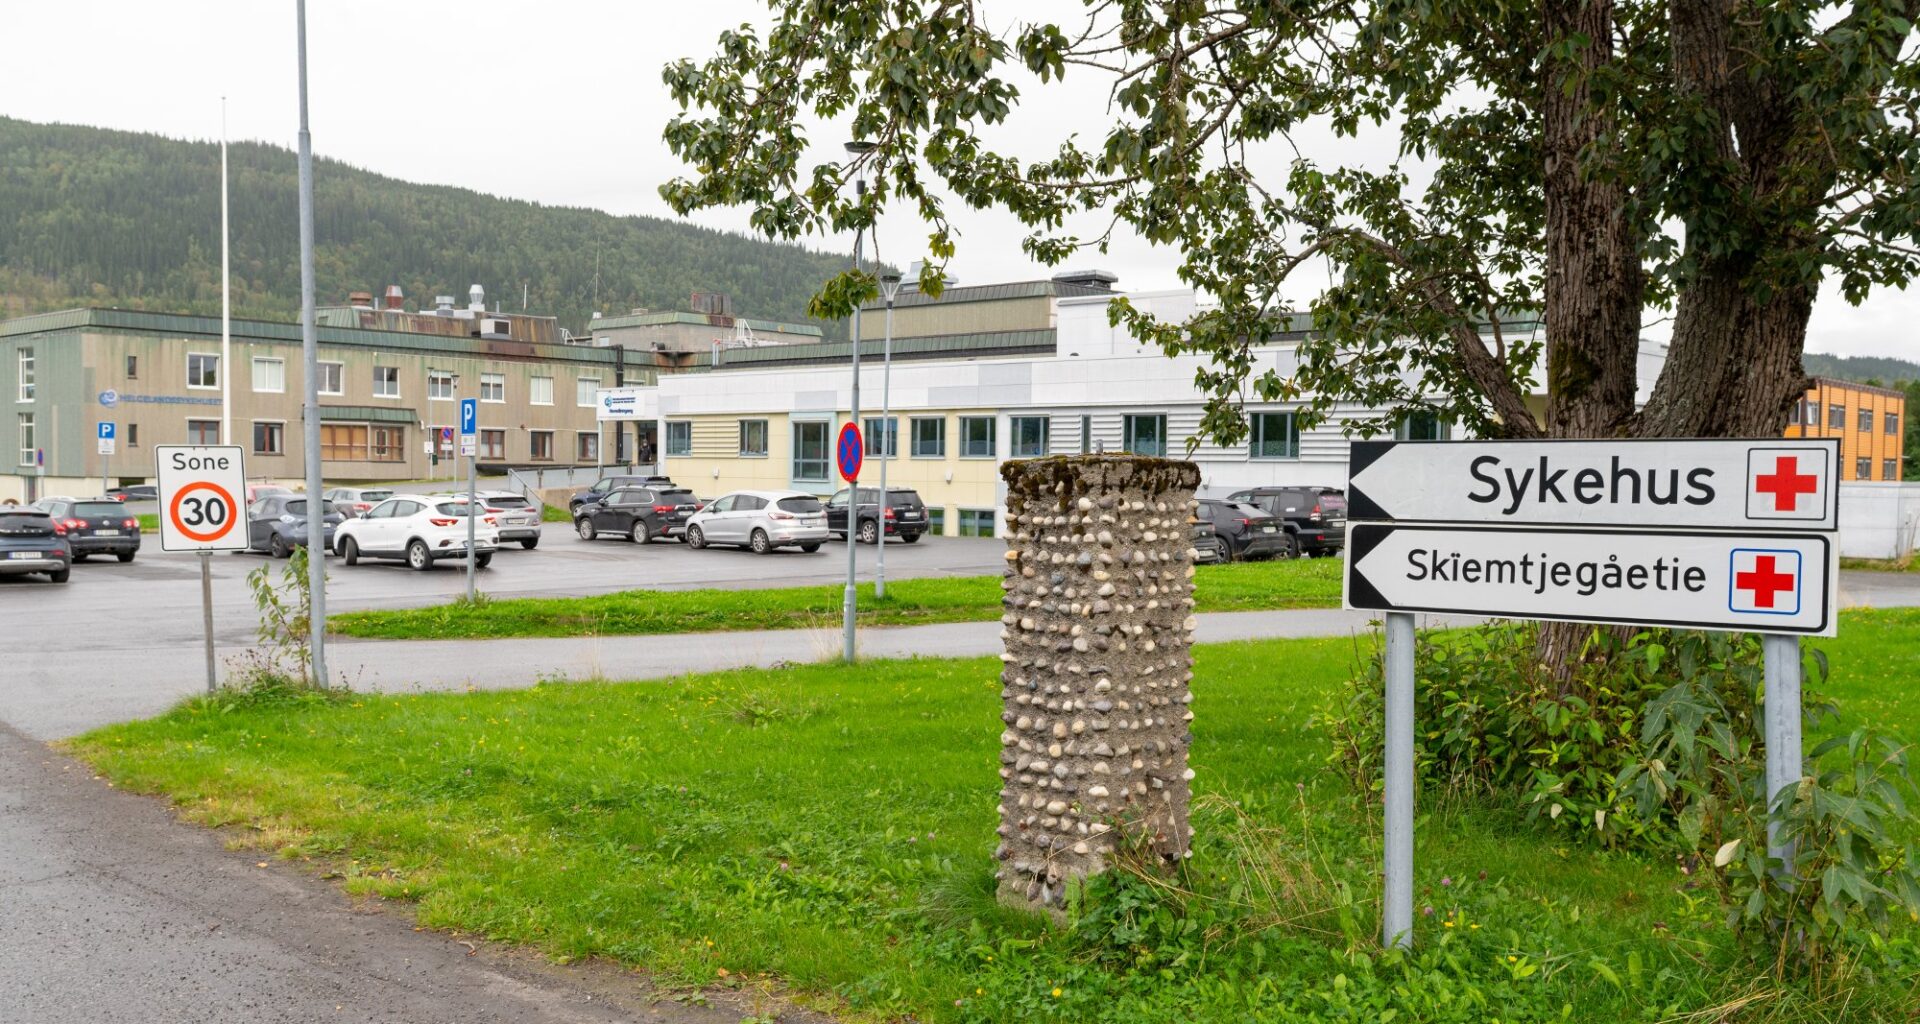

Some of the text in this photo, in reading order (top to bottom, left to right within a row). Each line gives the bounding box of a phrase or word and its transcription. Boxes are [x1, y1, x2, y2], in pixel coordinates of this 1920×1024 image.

[102, 424, 112, 437] P
[464, 403, 473, 430] P
[172, 452, 230, 471] Sone
[1467, 455, 1716, 515] Sykehus
[183, 497, 226, 526] 30
[1406, 548, 1707, 596] Skïemtjegåetie
